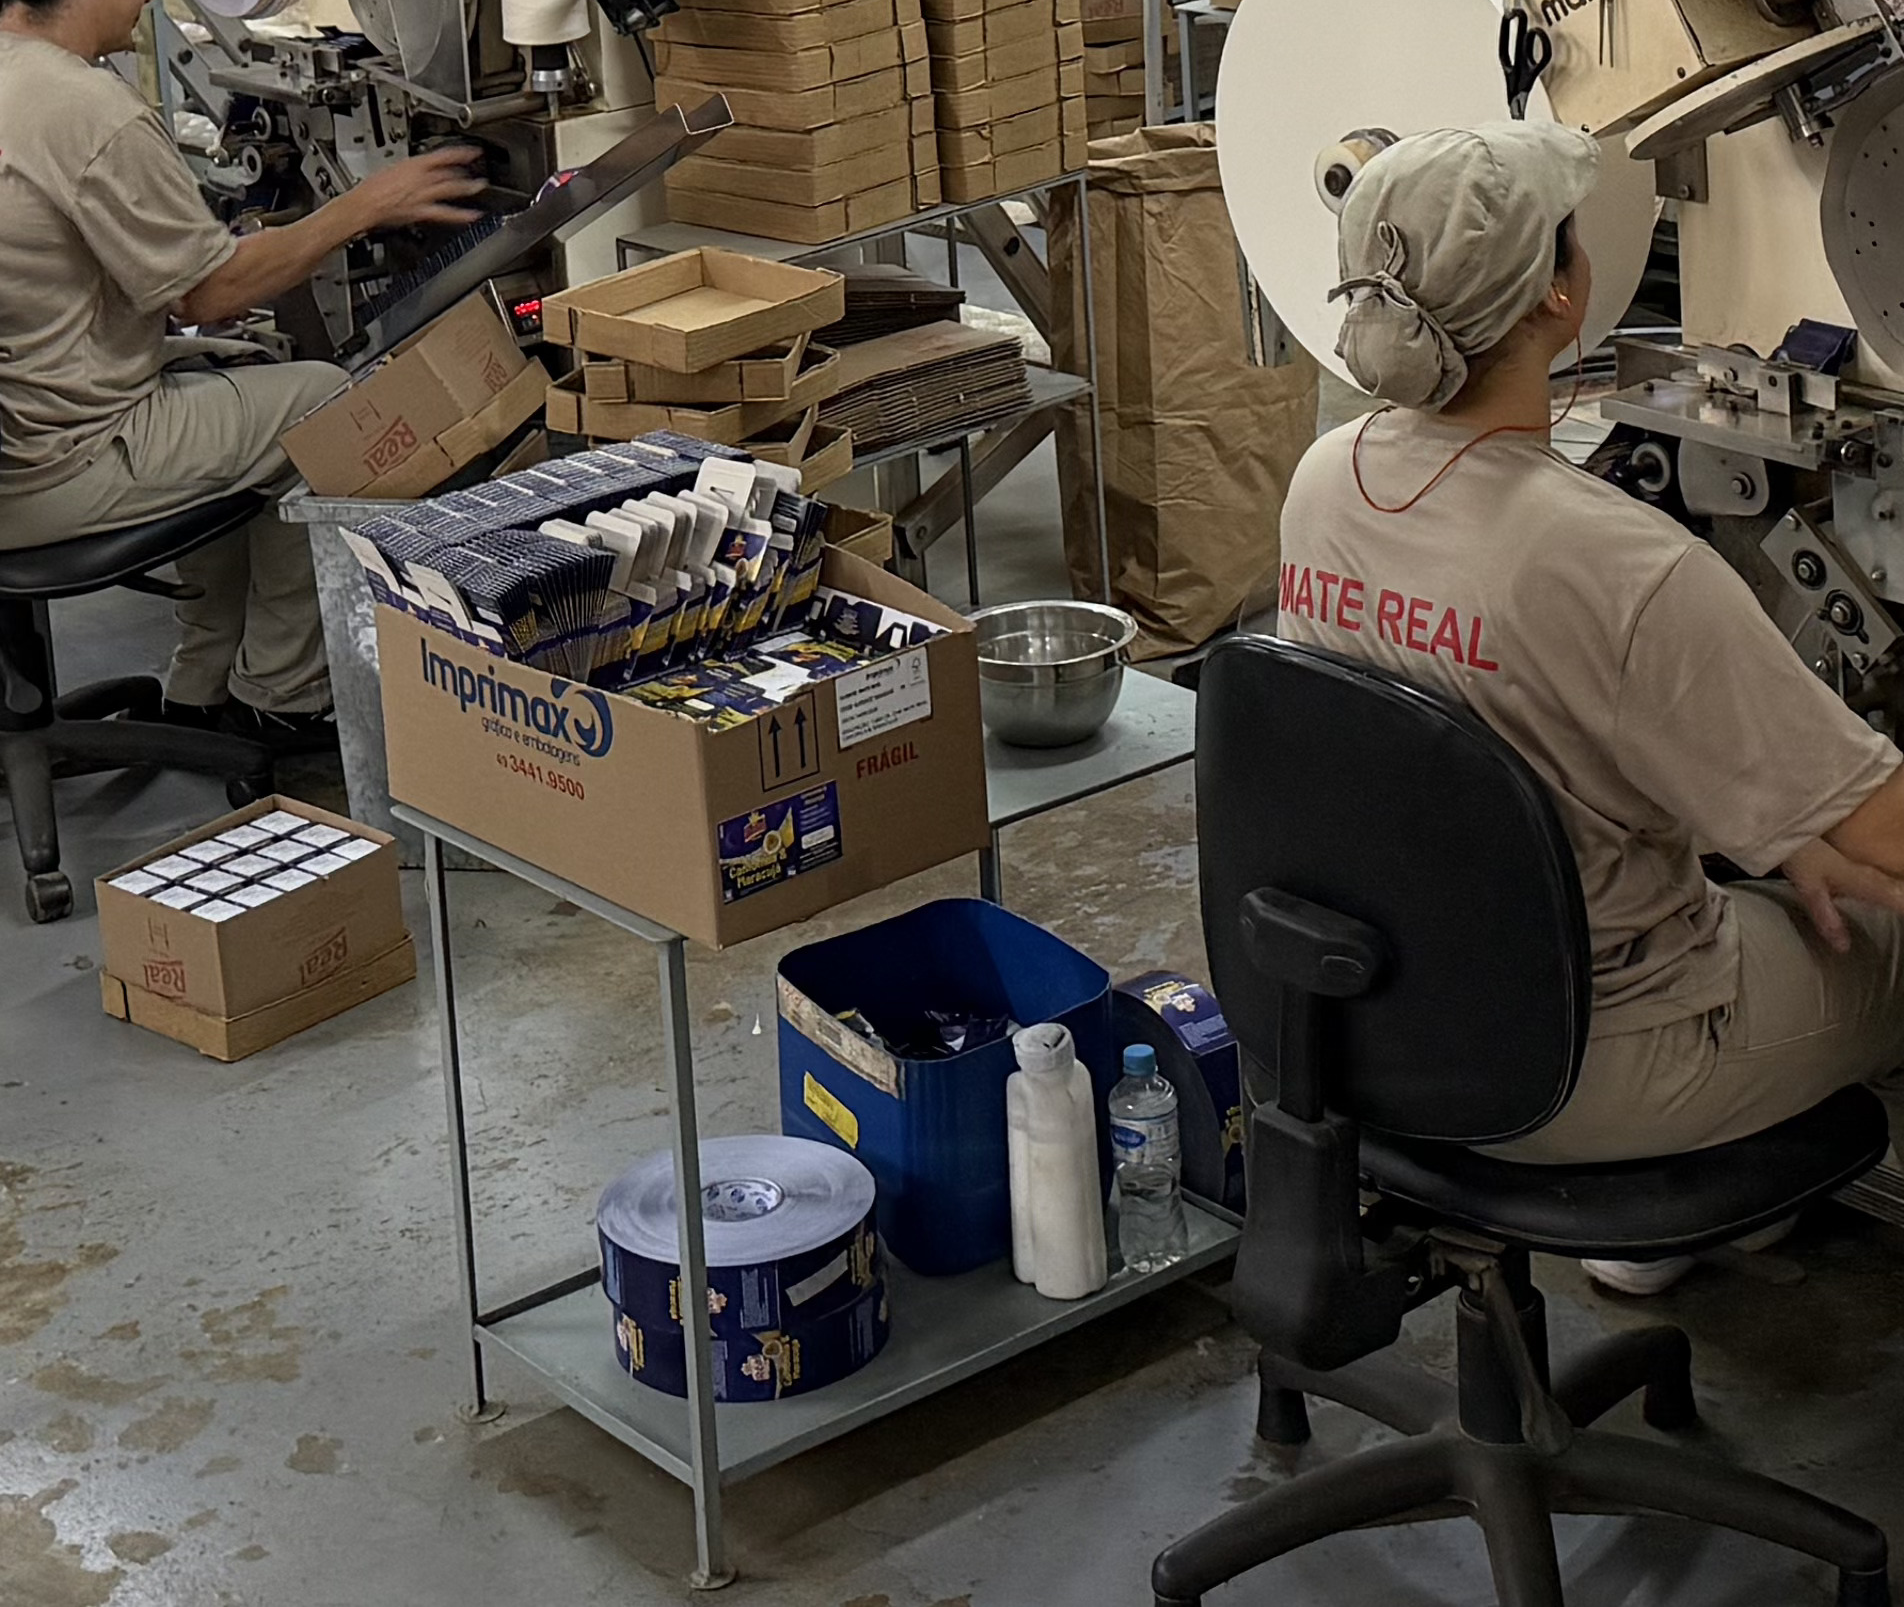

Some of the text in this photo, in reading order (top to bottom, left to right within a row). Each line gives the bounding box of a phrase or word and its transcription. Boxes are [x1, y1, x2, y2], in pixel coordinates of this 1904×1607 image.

[363, 420, 418, 475] Real
[1377, 588, 1499, 671] REAL
[420, 637, 573, 744] Imprimax
[510, 755, 585, 801] 3441.9500
[856, 740, 920, 779] FRÁGIL
[144, 965, 187, 993] Real
[300, 935, 348, 986] Real
